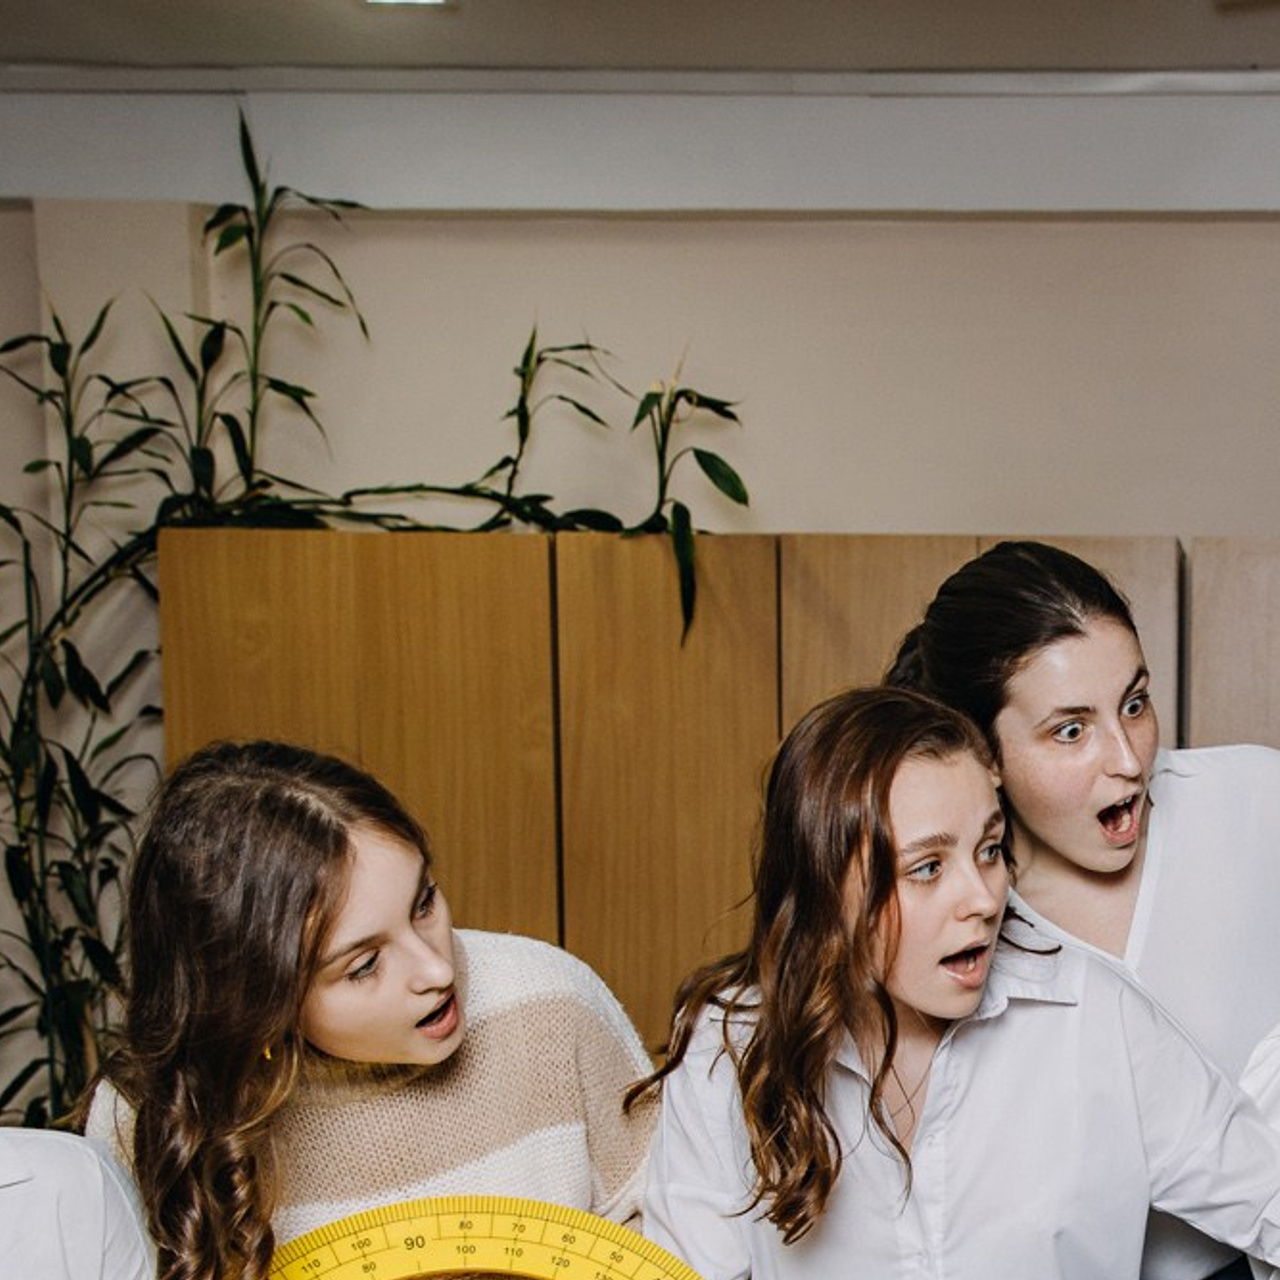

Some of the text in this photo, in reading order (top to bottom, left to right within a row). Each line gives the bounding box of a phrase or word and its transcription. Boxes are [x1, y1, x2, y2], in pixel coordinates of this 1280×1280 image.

[301, 1259, 321, 1274] 110
[351, 1238, 371, 1252] 100
[404, 1235, 426, 1251] 90
[459, 1221, 473, 1230] 80
[511, 1223, 526, 1233] 70
[561, 1234, 576, 1245] 60
[609, 1251, 624, 1264] 50
[362, 1261, 377, 1273] 80
[456, 1244, 476, 1255] 100
[504, 1247, 523, 1258] 110
[550, 1256, 570, 1268] 120
